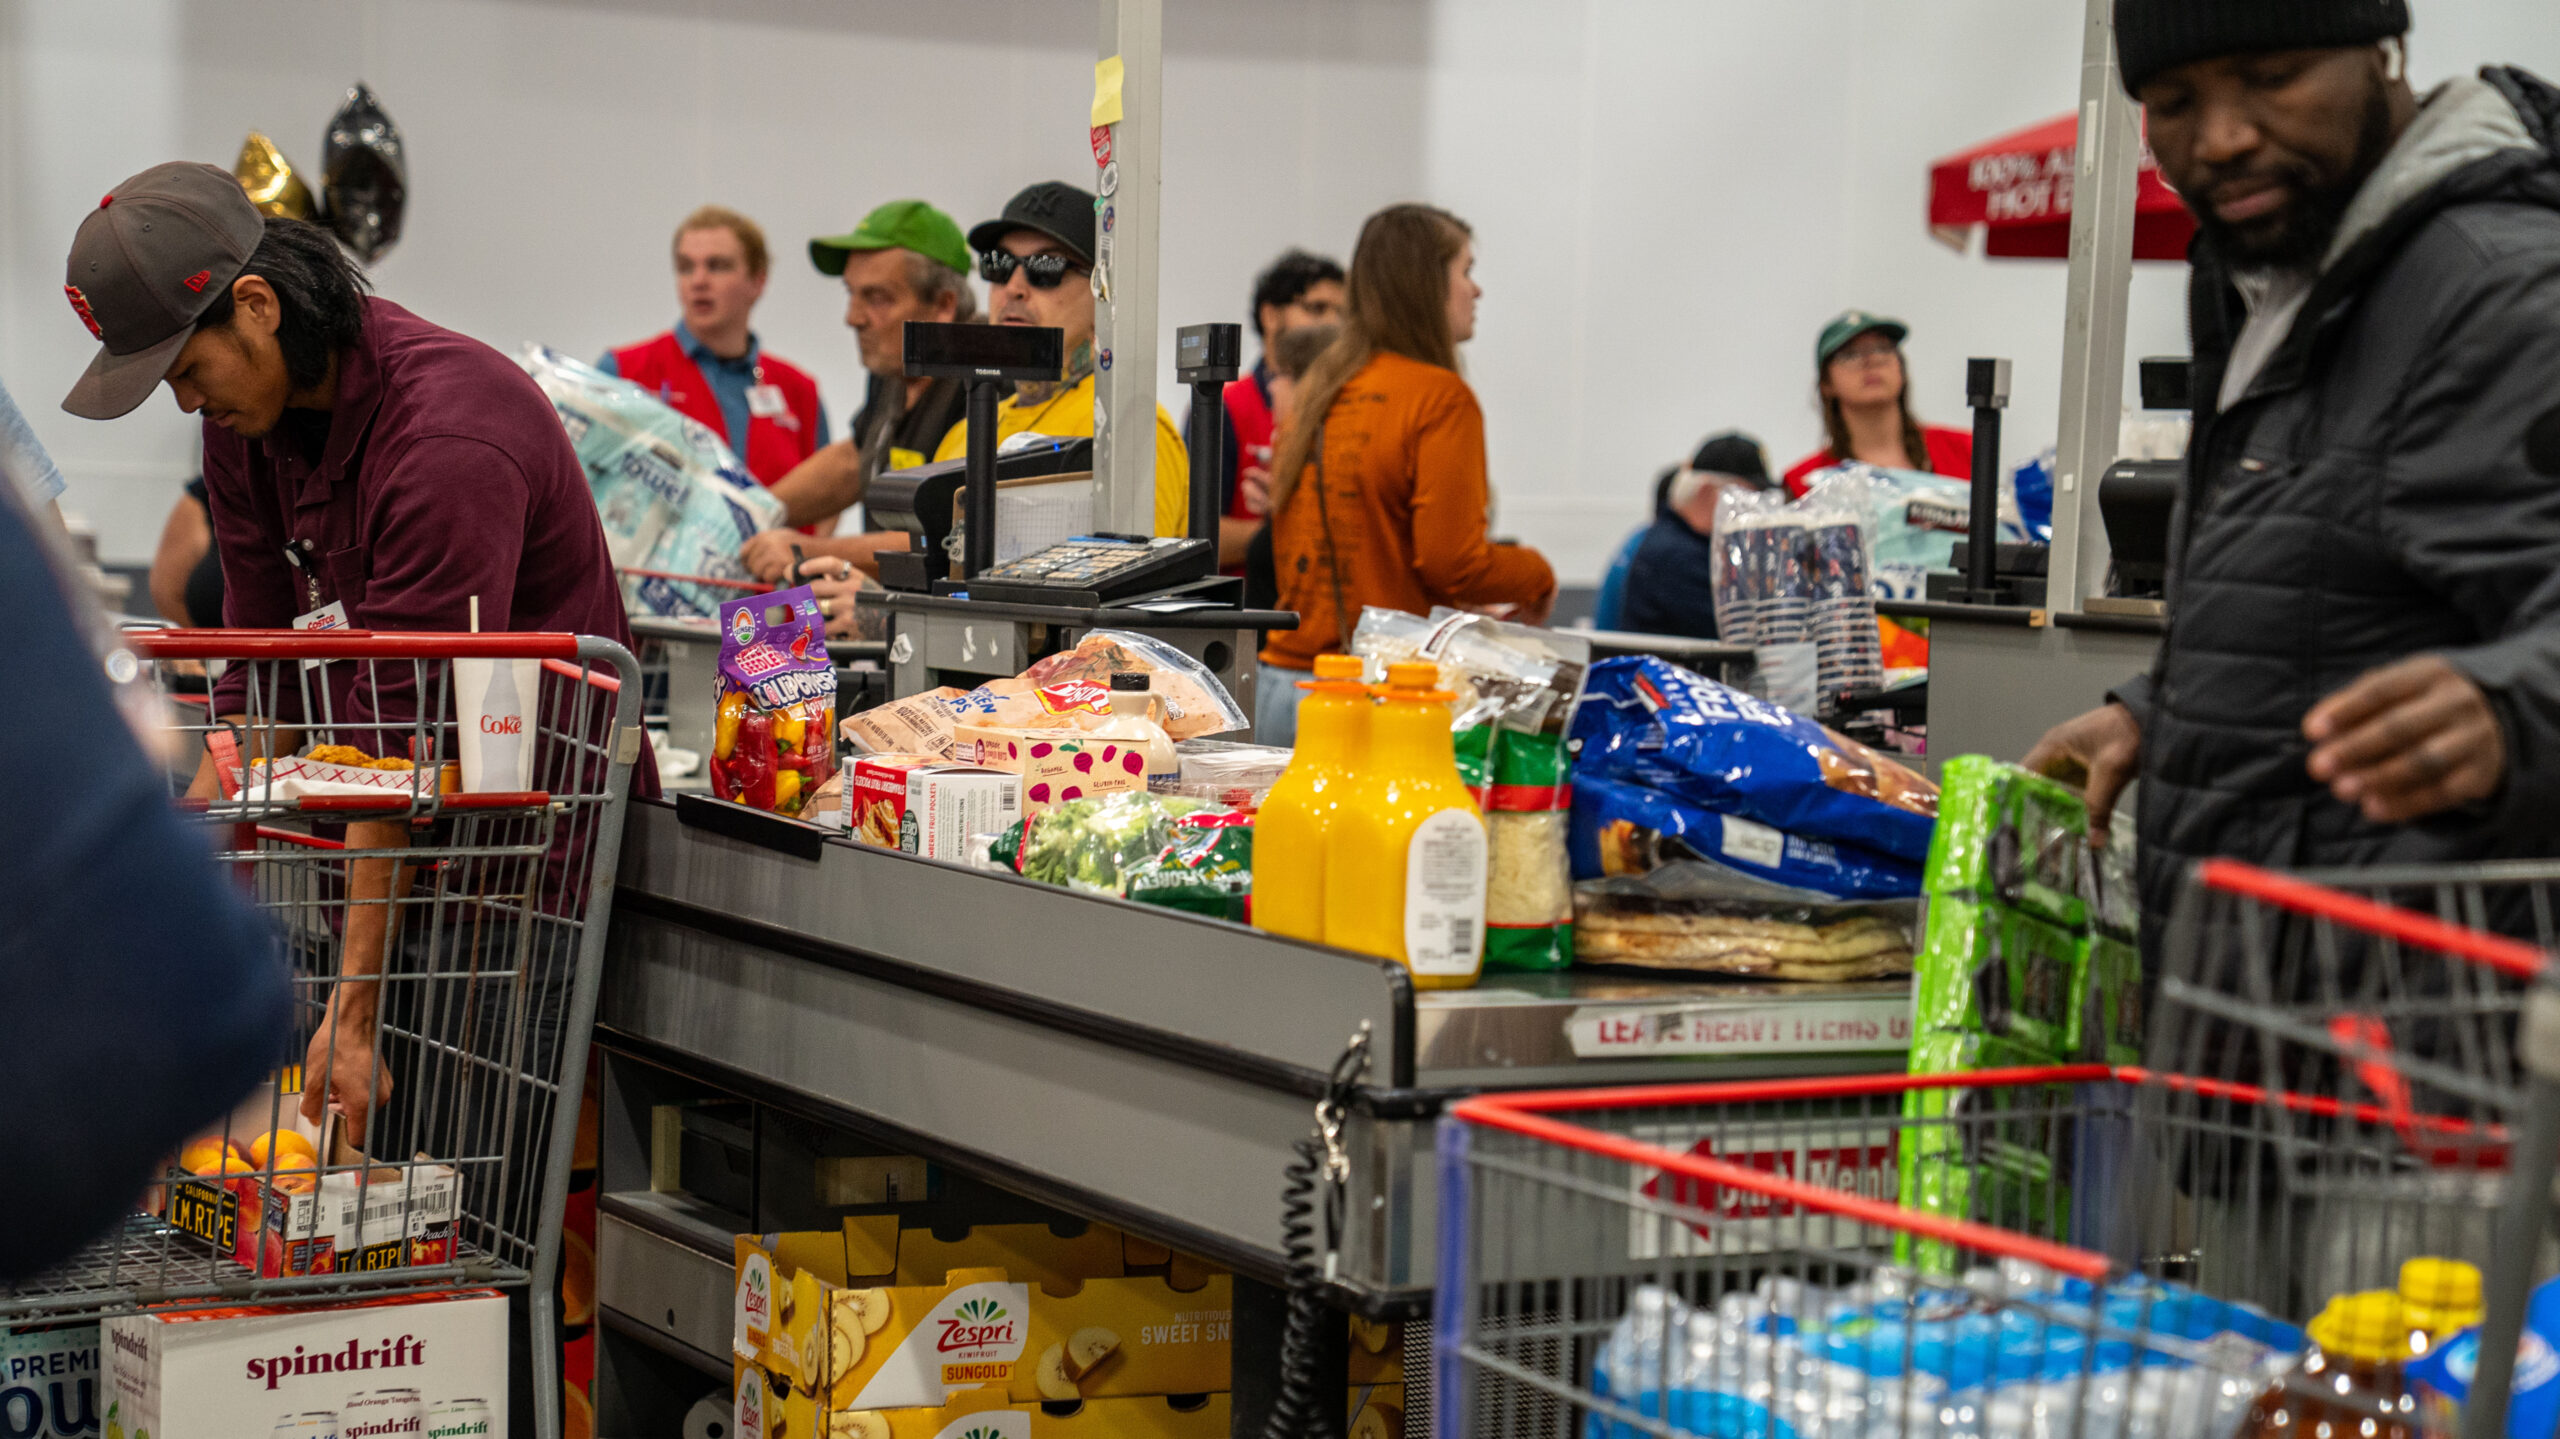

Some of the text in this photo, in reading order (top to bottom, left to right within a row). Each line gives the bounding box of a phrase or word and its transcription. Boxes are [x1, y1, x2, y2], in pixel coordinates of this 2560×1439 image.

[975, 368, 1001, 376] TOSHIBA
[308, 614, 335, 631] COSTCO
[734, 626, 755, 636] SUNSET
[480, 714, 522, 735] Coke
[929, 782, 937, 811] POCKETS
[928, 812, 936, 829] FRUIT
[417, 1226, 456, 1242] Peachs
[745, 1281, 767, 1316] Zespri
[112, 1328, 148, 1361] spindrift
[937, 1319, 1015, 1353] Zespri
[1141, 1324, 1199, 1345] SWEET
[246, 1334, 426, 1391] spindrift
[958, 1350, 998, 1359] KIWIFRUIT
[946, 1363, 1008, 1381] SUNGOLD
[345, 1416, 421, 1439] spindrift
[427, 1420, 488, 1439] spindrift
